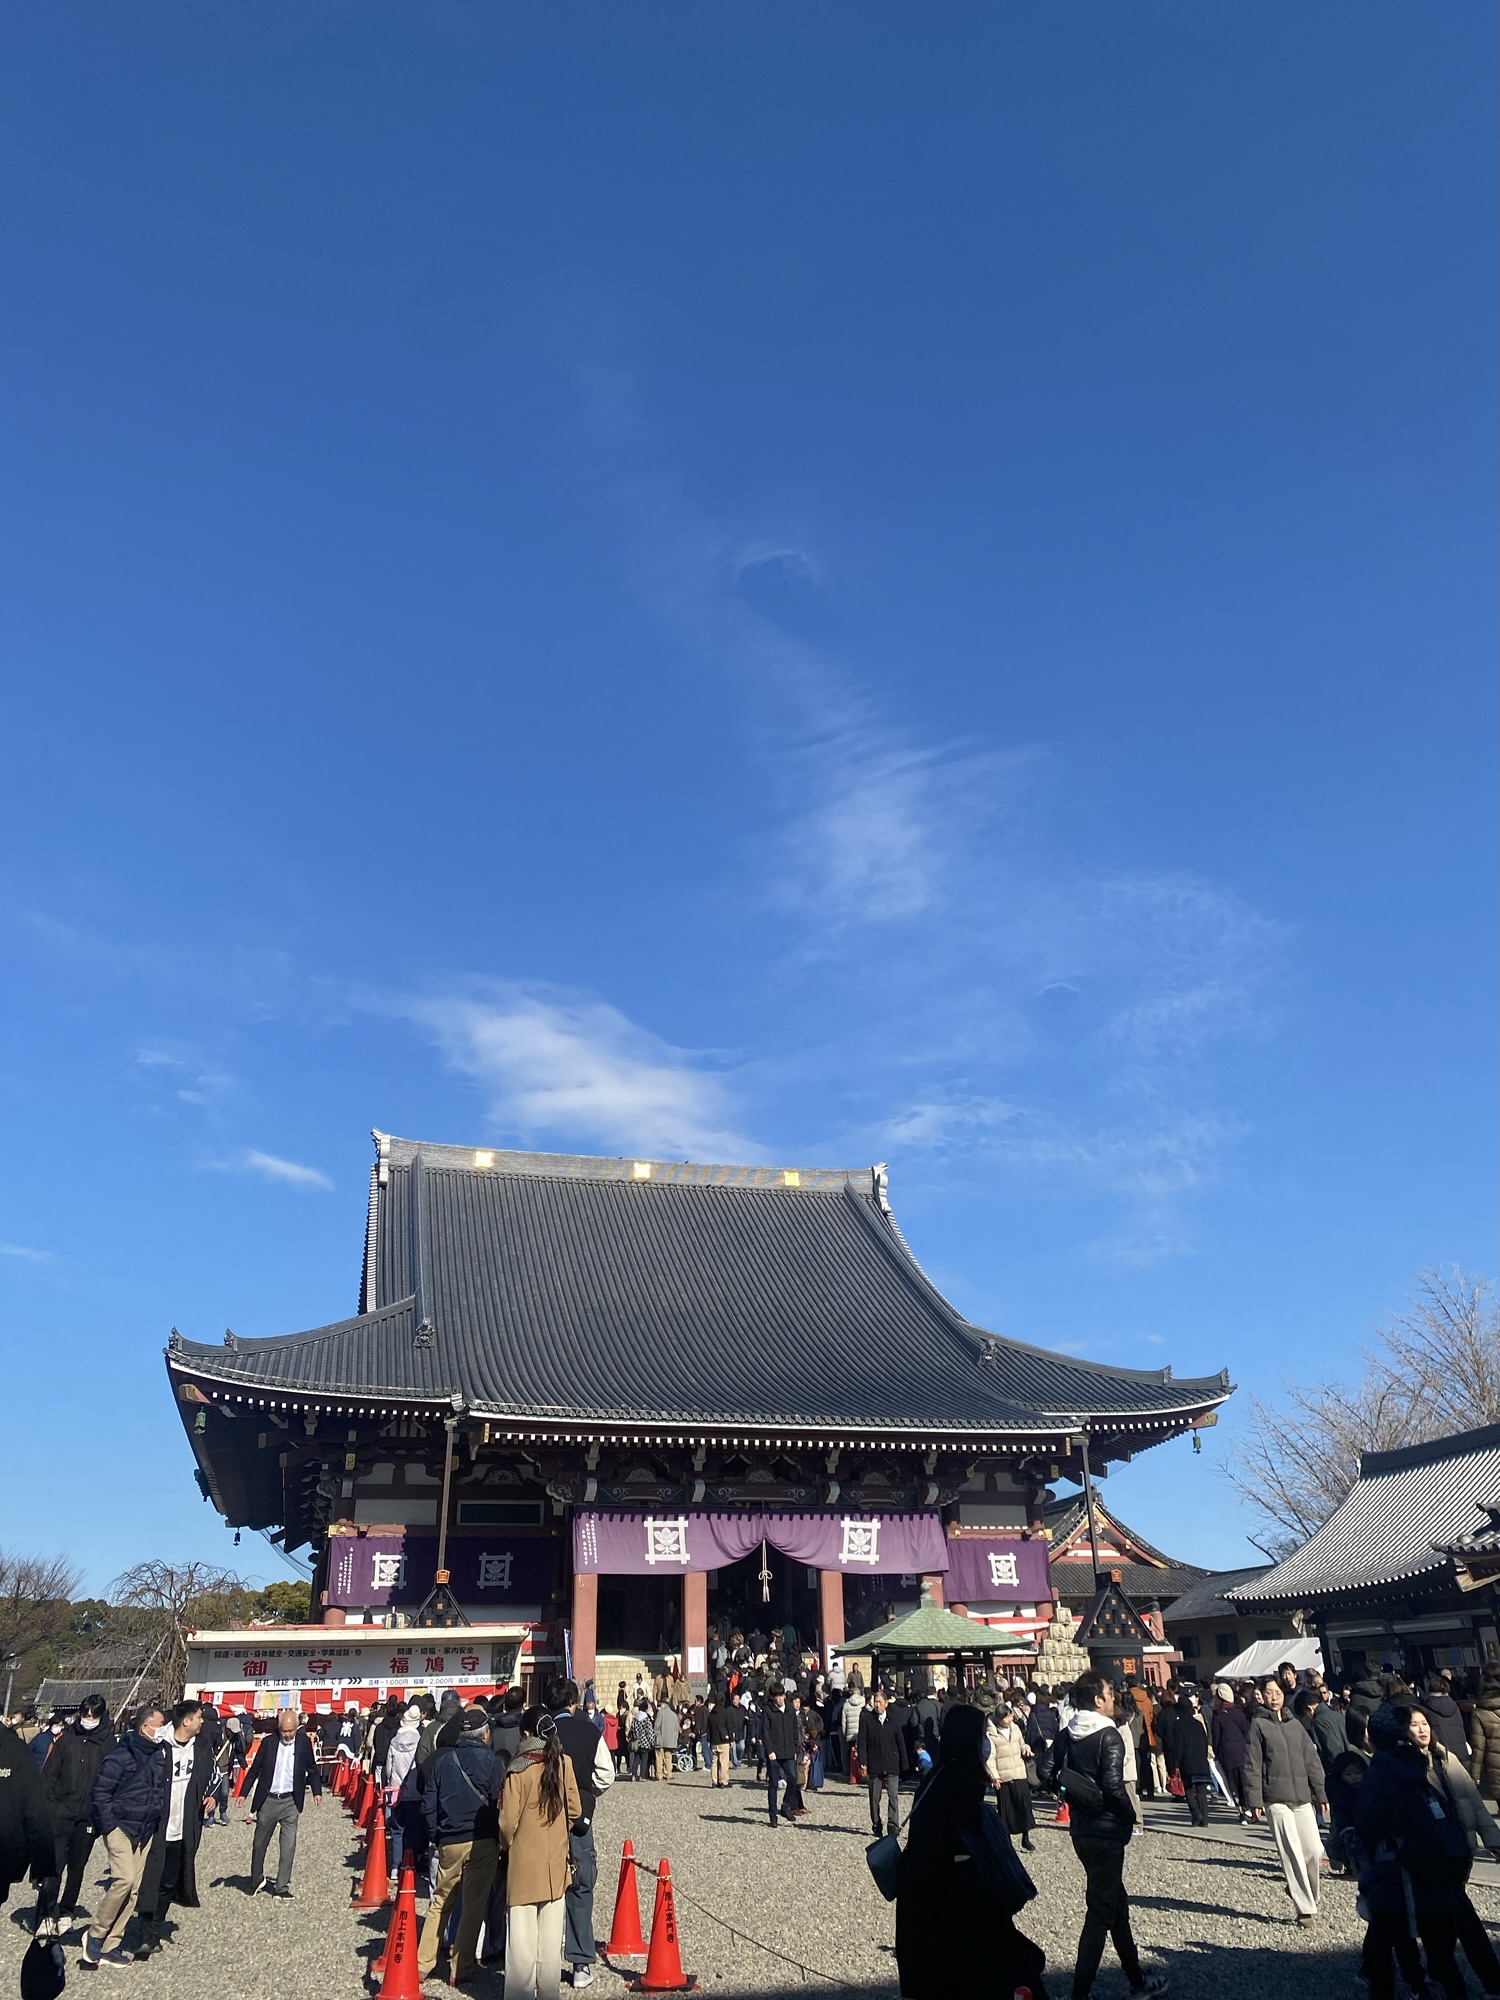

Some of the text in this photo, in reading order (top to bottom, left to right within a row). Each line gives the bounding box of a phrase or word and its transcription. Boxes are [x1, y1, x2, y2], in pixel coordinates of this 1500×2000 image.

[394, 1910, 408, 1963] 池上本門寺
[665, 1891, 675, 1943] 池上本門寺
